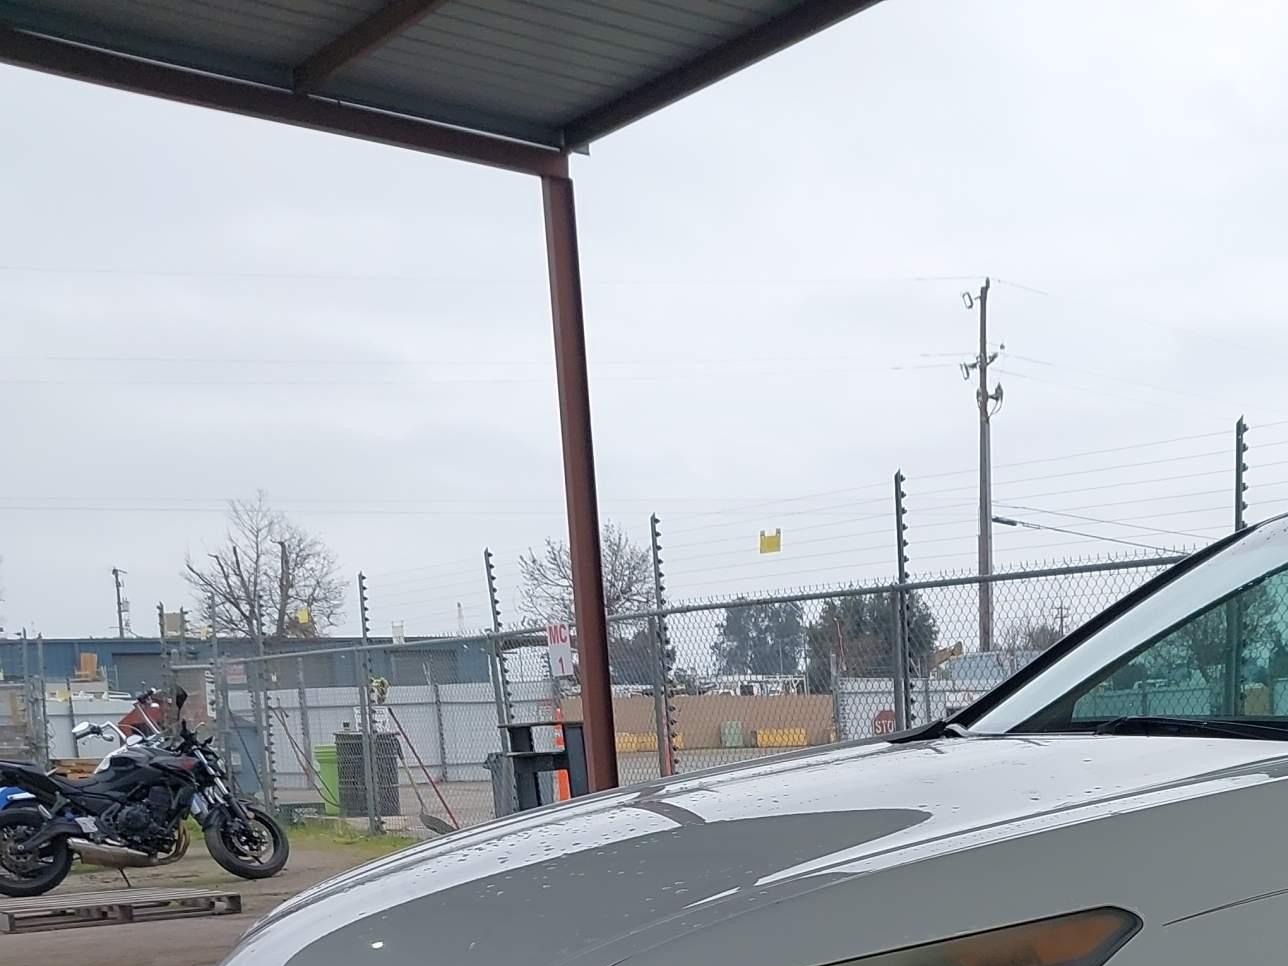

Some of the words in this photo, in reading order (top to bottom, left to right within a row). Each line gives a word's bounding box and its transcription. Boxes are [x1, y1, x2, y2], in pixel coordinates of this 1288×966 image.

[548, 624, 568, 645] MC
[558, 656, 565, 674] 1
[875, 720, 897, 734] STO
